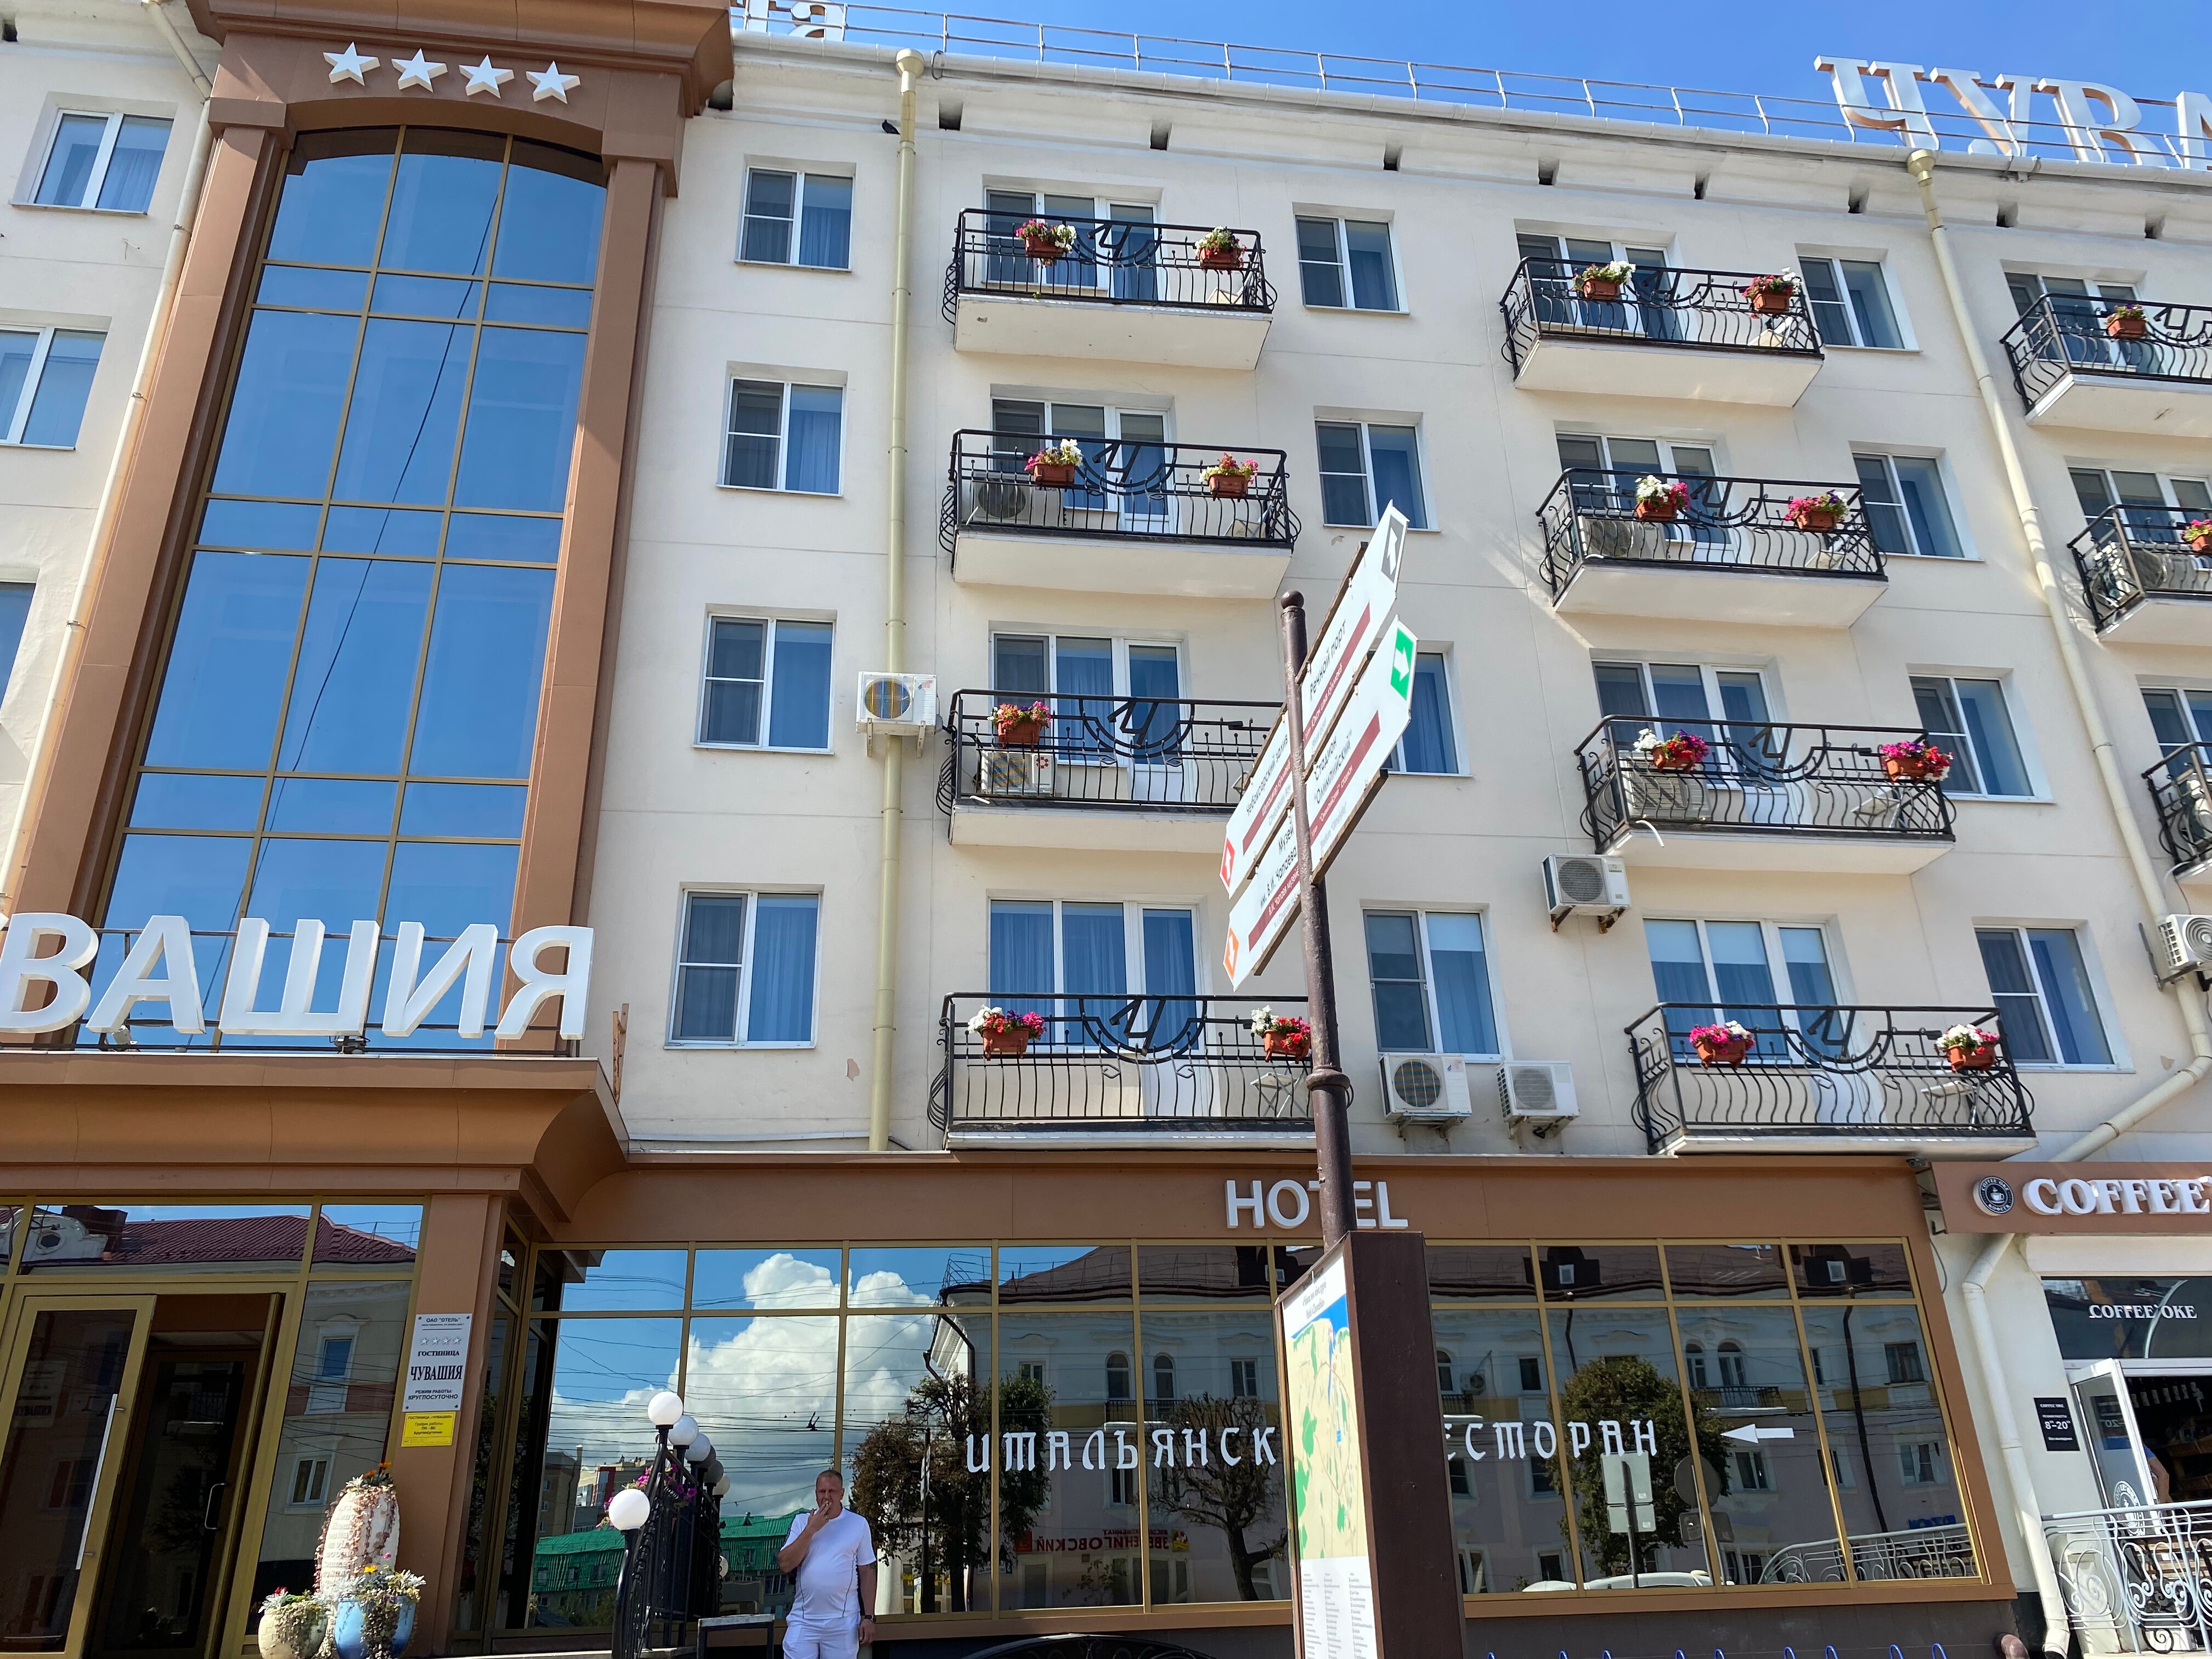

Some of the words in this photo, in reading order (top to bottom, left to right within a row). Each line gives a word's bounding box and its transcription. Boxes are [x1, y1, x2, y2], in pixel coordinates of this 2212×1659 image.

[1310, 650, 1330, 701] Речной
[1331, 619, 1346, 659] порт
[1246, 754, 1276, 816] Чебоксарский
[1276, 734, 1288, 761] залив
[1315, 735, 1337, 781] Стадион
[1278, 817, 1294, 855] Музей
[1276, 845, 1297, 882] Чапаева
[0, 912, 596, 1040] ВАШИЯ
[411, 1365, 463, 1381] ЧУВАШИЯ
[966, 1427, 1277, 1473] ИТАЛЬЯНСК
